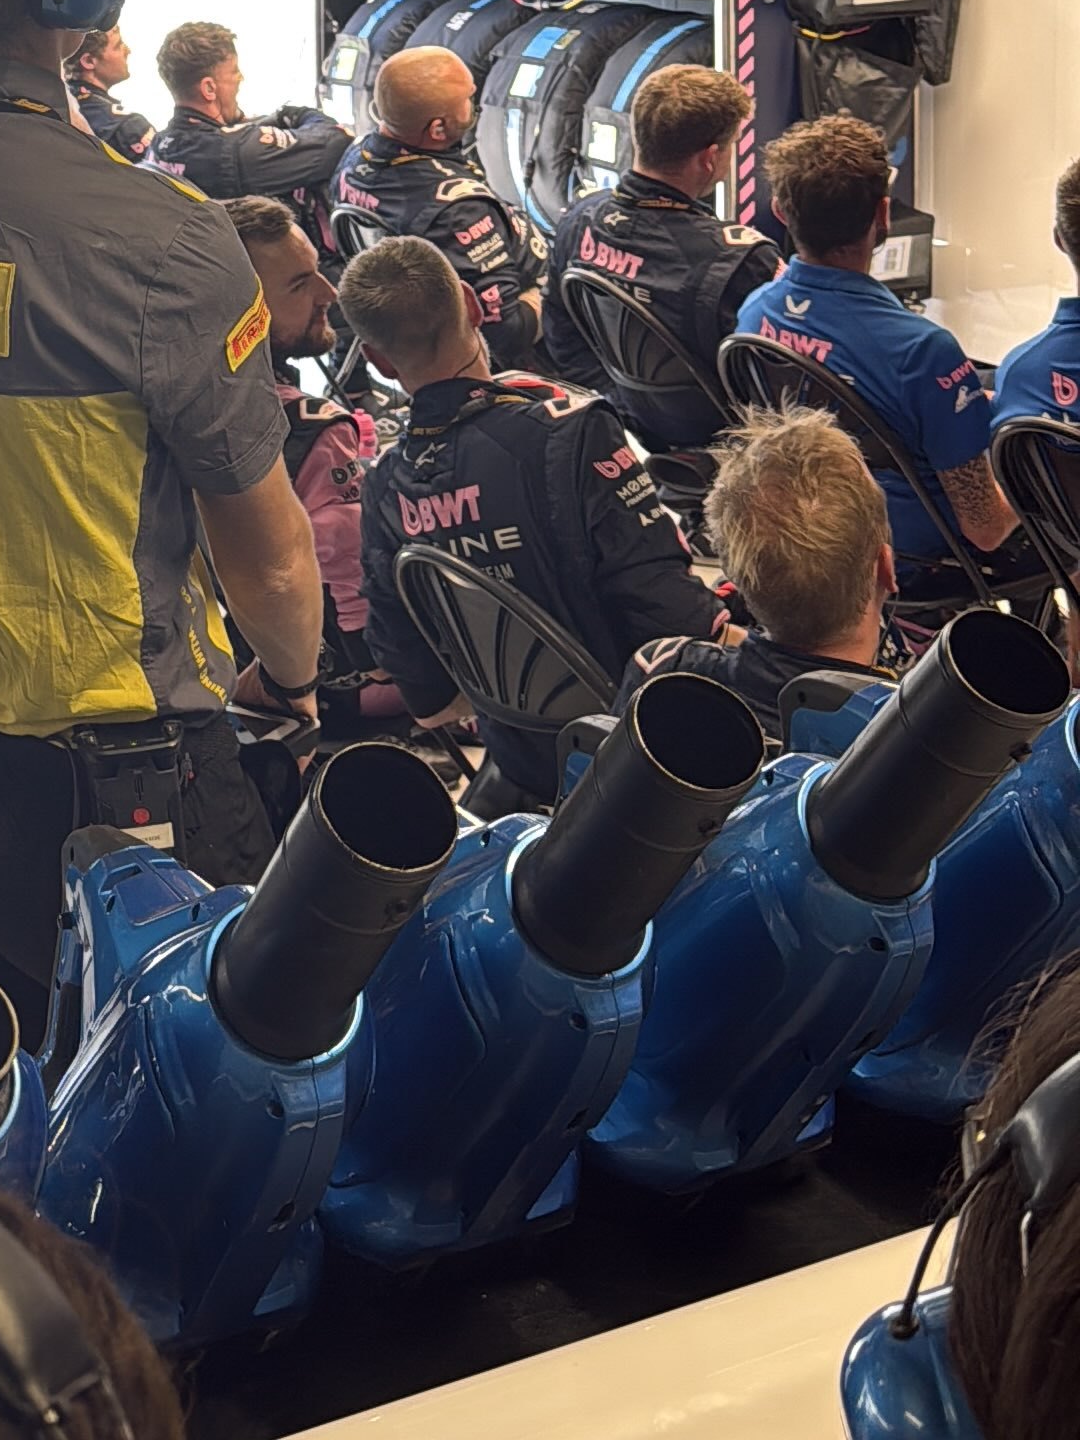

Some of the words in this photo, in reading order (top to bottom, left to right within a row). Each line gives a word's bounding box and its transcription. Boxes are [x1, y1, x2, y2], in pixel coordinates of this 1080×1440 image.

[469, 215, 495, 240] BWT
[593, 242, 644, 280] BWT
[779, 330, 834, 364] BWT
[418, 485, 481, 535] BWT
[448, 526, 523, 558] INE
[481, 563, 515, 582] EAM
